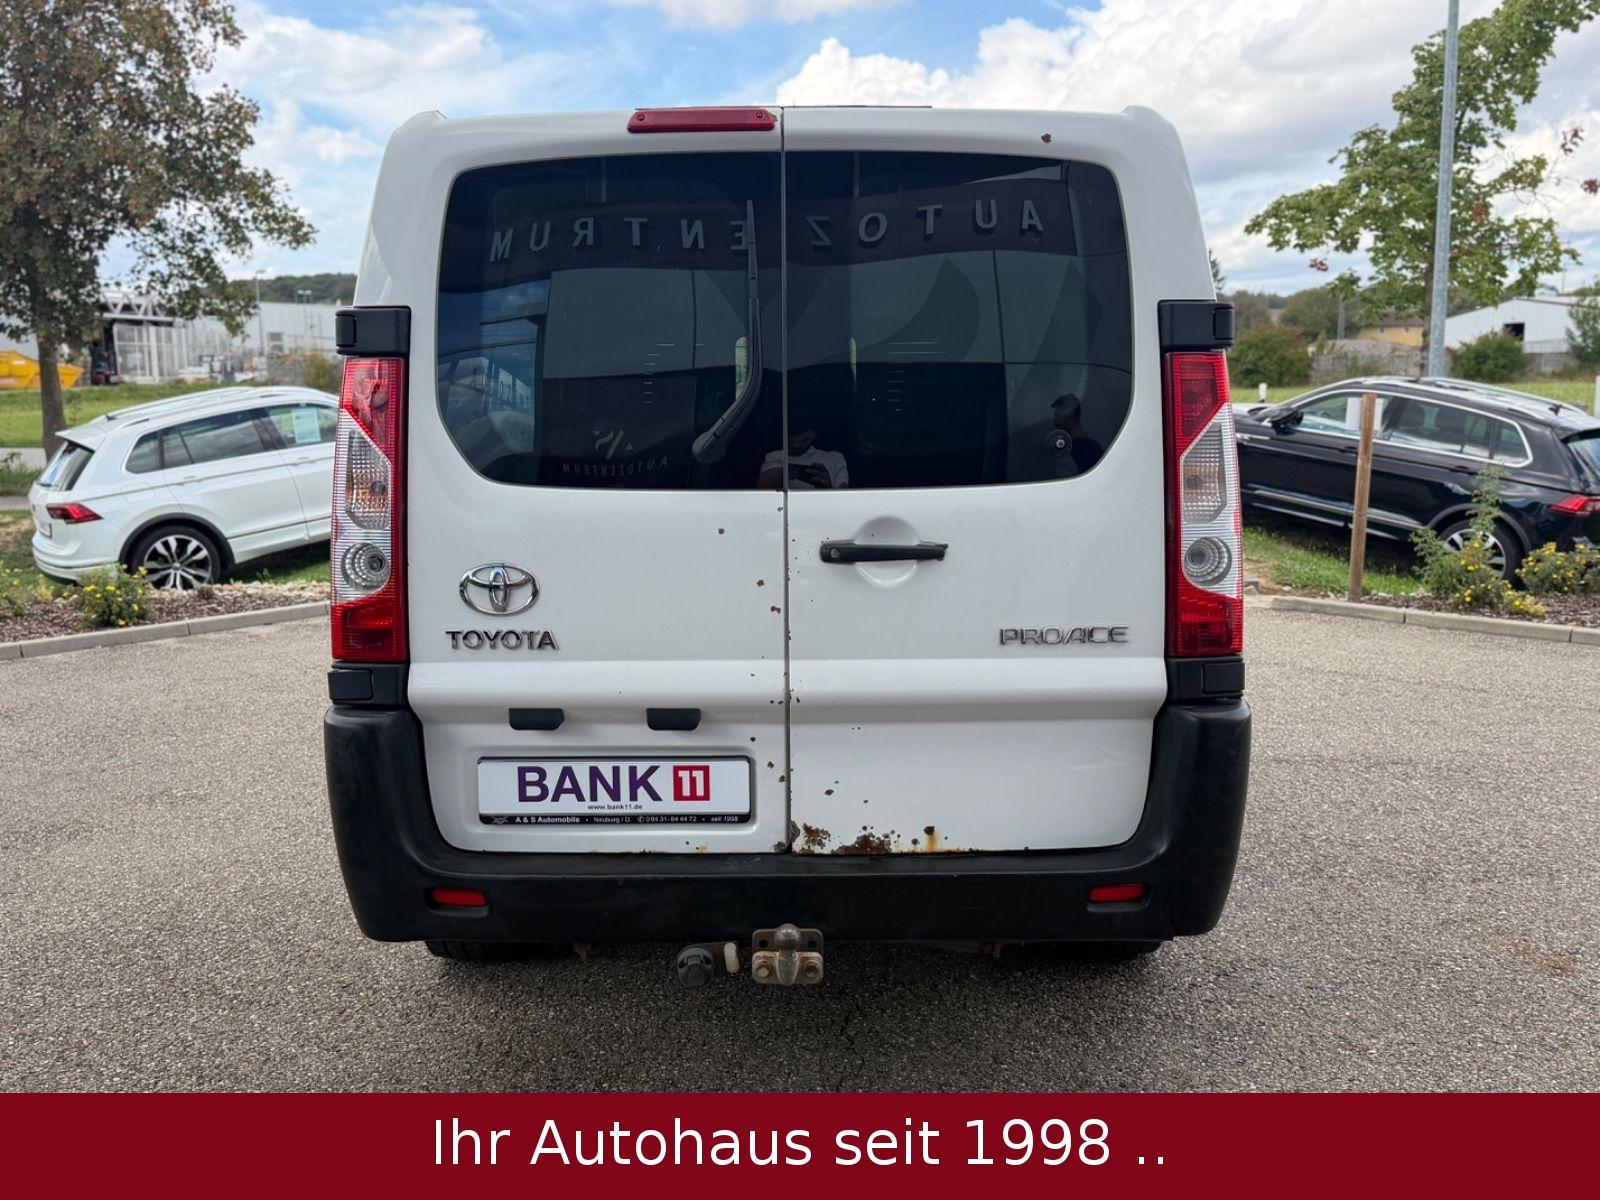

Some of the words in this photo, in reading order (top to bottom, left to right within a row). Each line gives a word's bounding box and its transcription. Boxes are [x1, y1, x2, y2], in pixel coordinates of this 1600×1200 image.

[446, 629, 560, 650] TOYOTA
[1000, 625, 1130, 645] PROACE
[516, 765, 663, 802] BANK
[677, 770, 705, 797] 11
[587, 803, 644, 811] www.bank11.de
